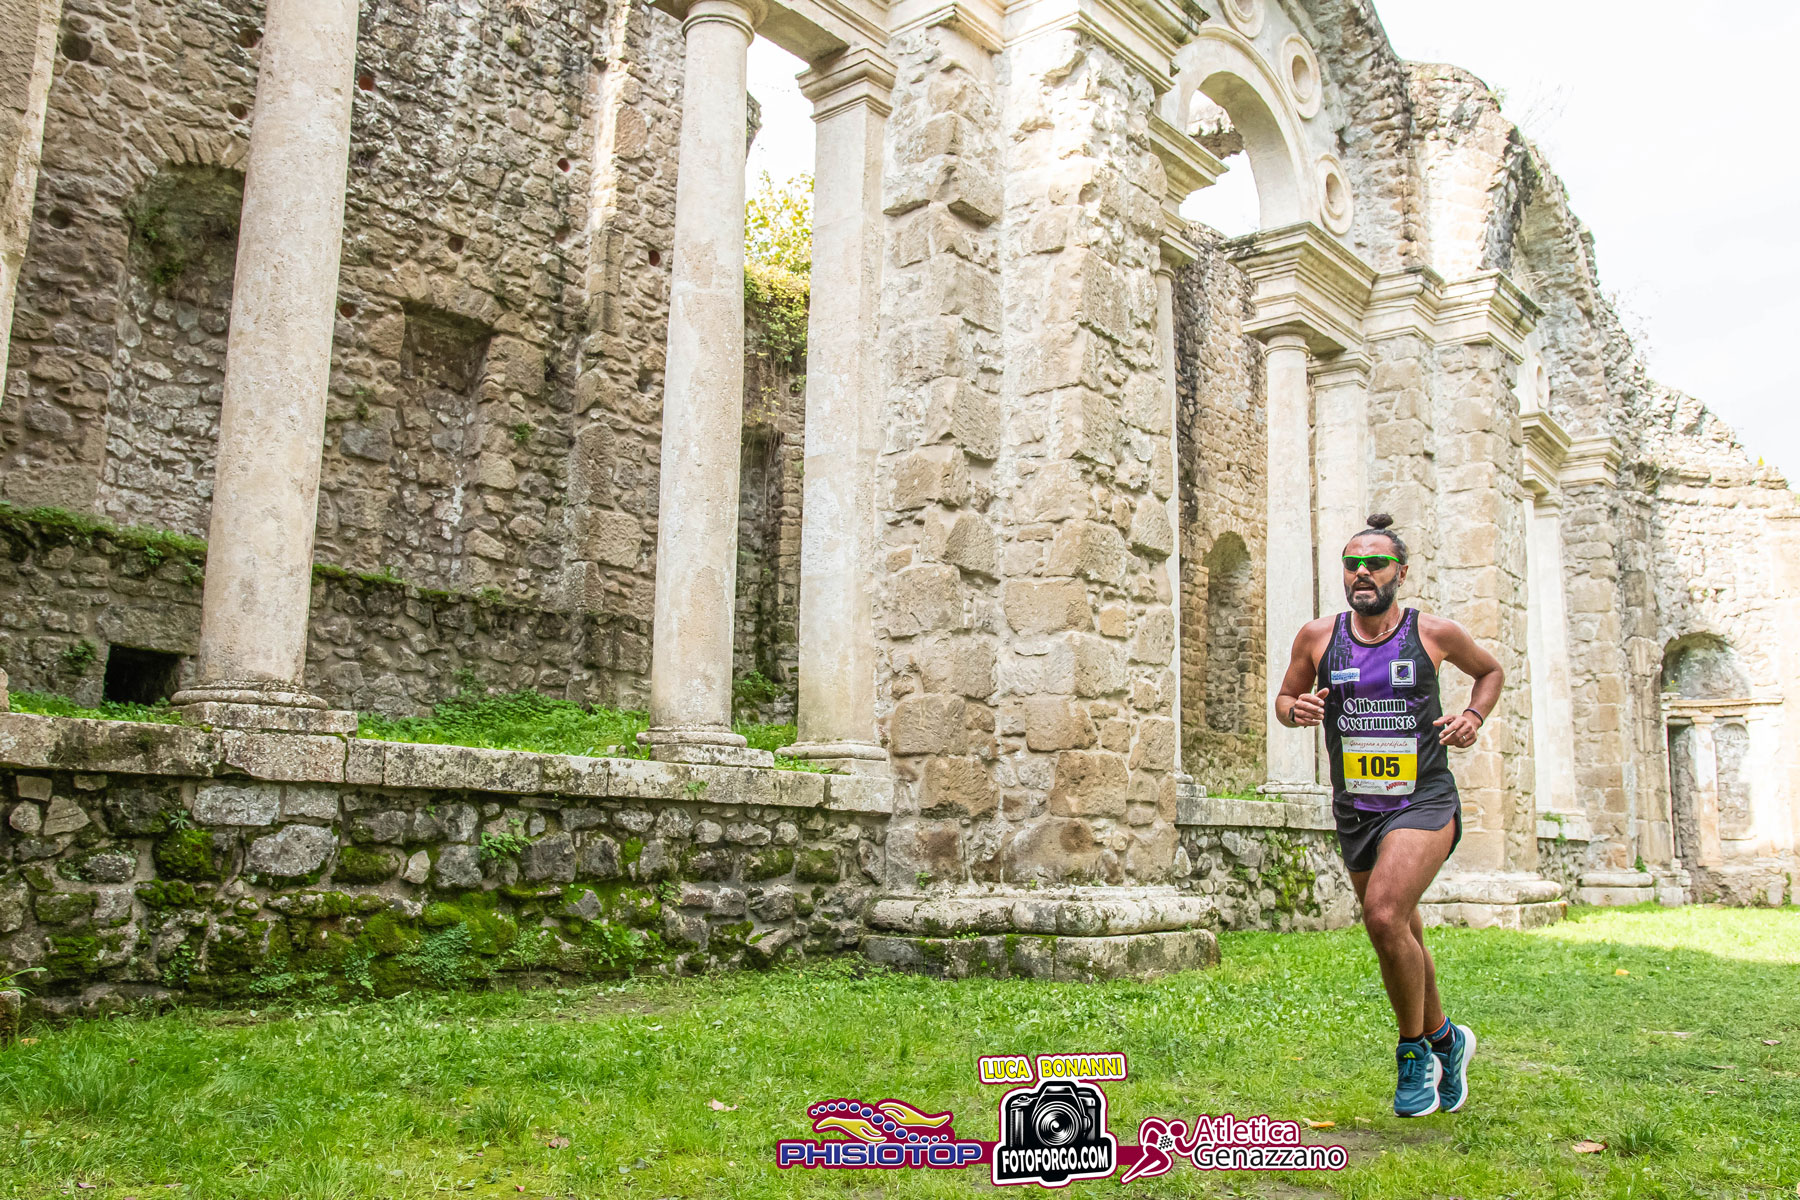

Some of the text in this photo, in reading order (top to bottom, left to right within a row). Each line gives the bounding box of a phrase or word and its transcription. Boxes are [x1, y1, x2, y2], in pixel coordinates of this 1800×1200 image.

[1343, 698, 1406, 714] Olibanum
[1338, 715, 1416, 731] Overrunners
[1358, 755, 1400, 777] 105
